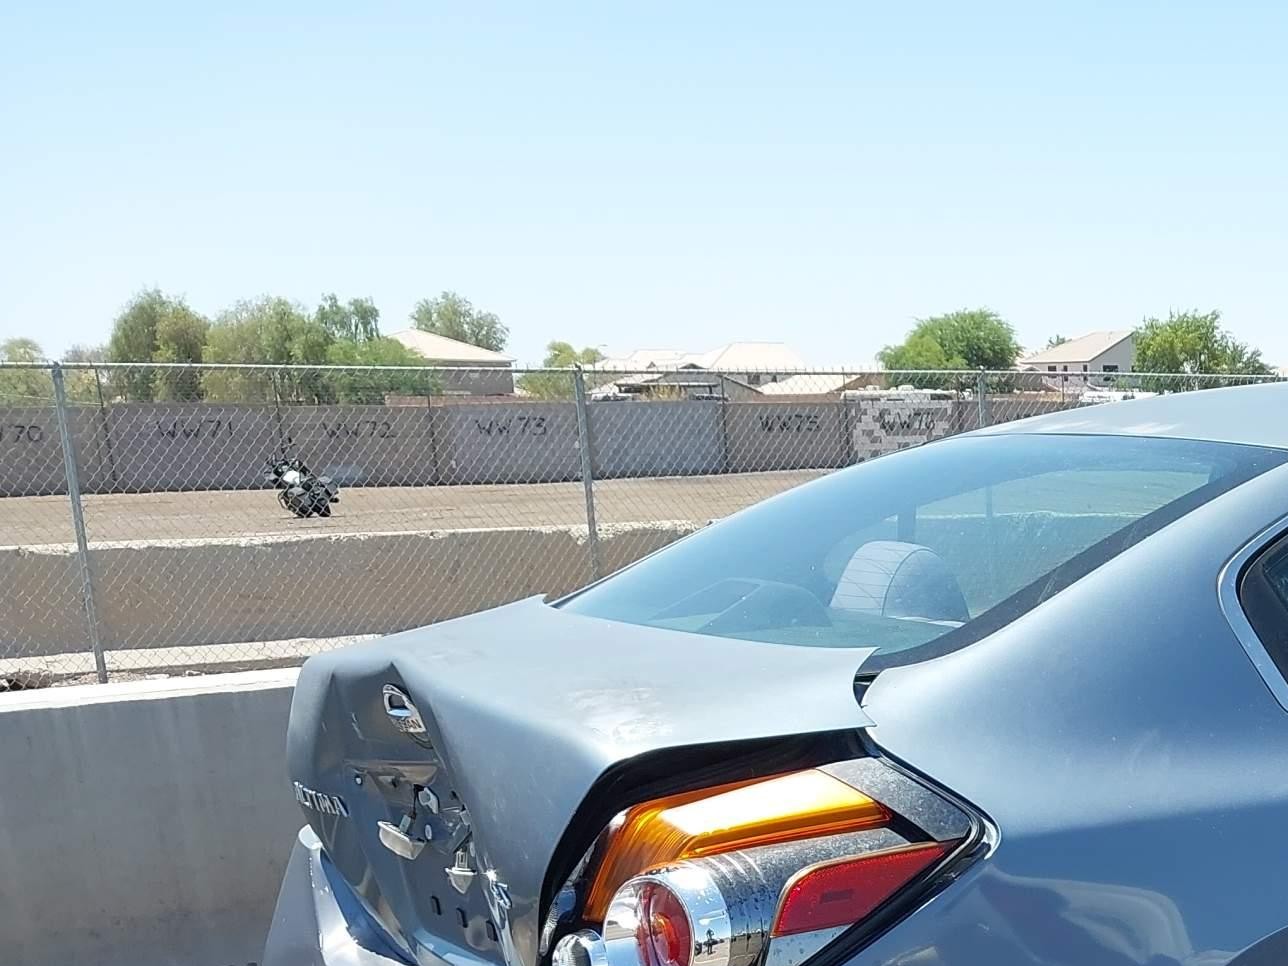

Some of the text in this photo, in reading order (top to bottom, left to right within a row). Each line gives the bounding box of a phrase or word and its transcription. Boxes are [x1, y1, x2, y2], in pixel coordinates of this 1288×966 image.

[0, 425, 43, 443] 70
[155, 420, 234, 438] WW71
[321, 420, 398, 439] WW72
